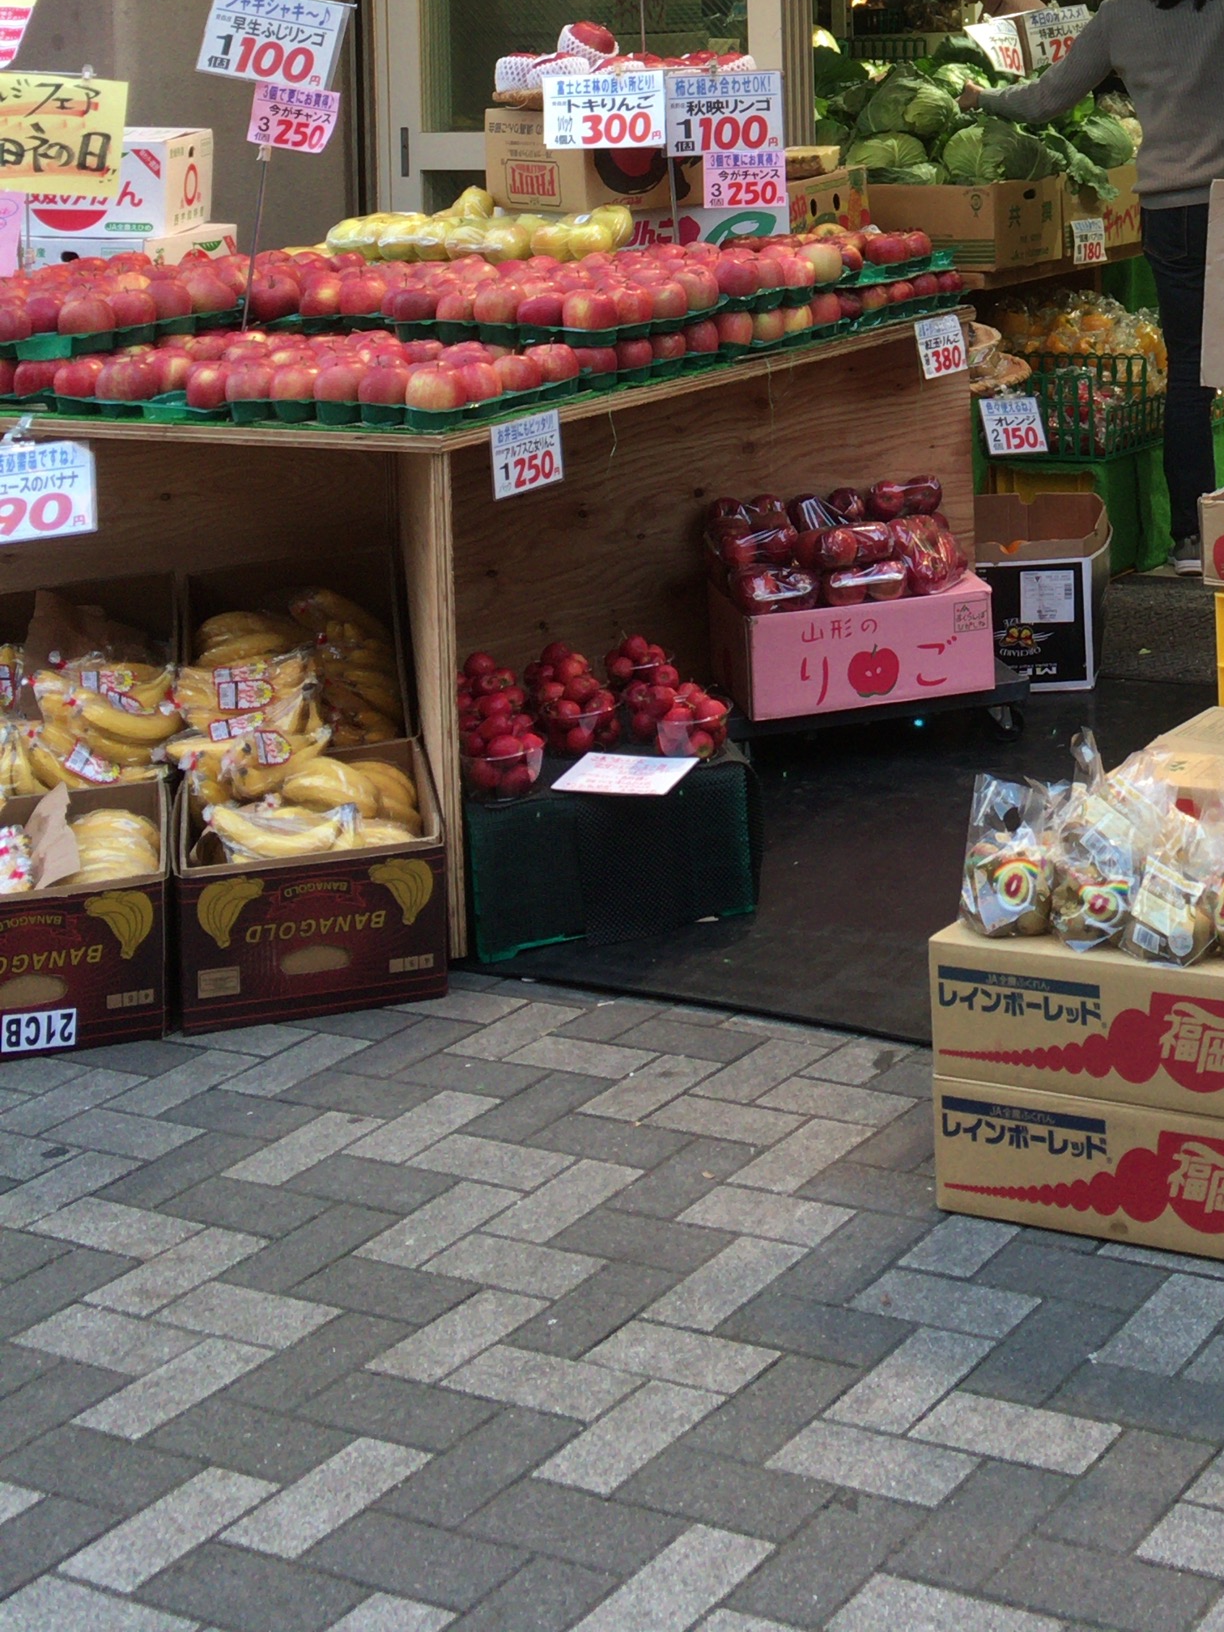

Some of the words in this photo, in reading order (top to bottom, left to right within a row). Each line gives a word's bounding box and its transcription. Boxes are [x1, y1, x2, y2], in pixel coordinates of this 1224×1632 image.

[231, 16, 327, 47] 早生ふじリンゴ
[269, 104, 331, 124] 今がチャンス
[685, 96, 772, 117] 秋映リンゴ
[718, 168, 781, 180] 今がチャンス
[995, 416, 1036, 427] オレンジ
[801, 617, 878, 644] 山形の
[284, 880, 349, 897] BANAGOLD
[245, 910, 387, 944] BANAGOLD
[938, 981, 1101, 1027] レインボーレッド
[5, 1011, 74, 1048] 21CB
[941, 1112, 1108, 1161] レインボーレッド
